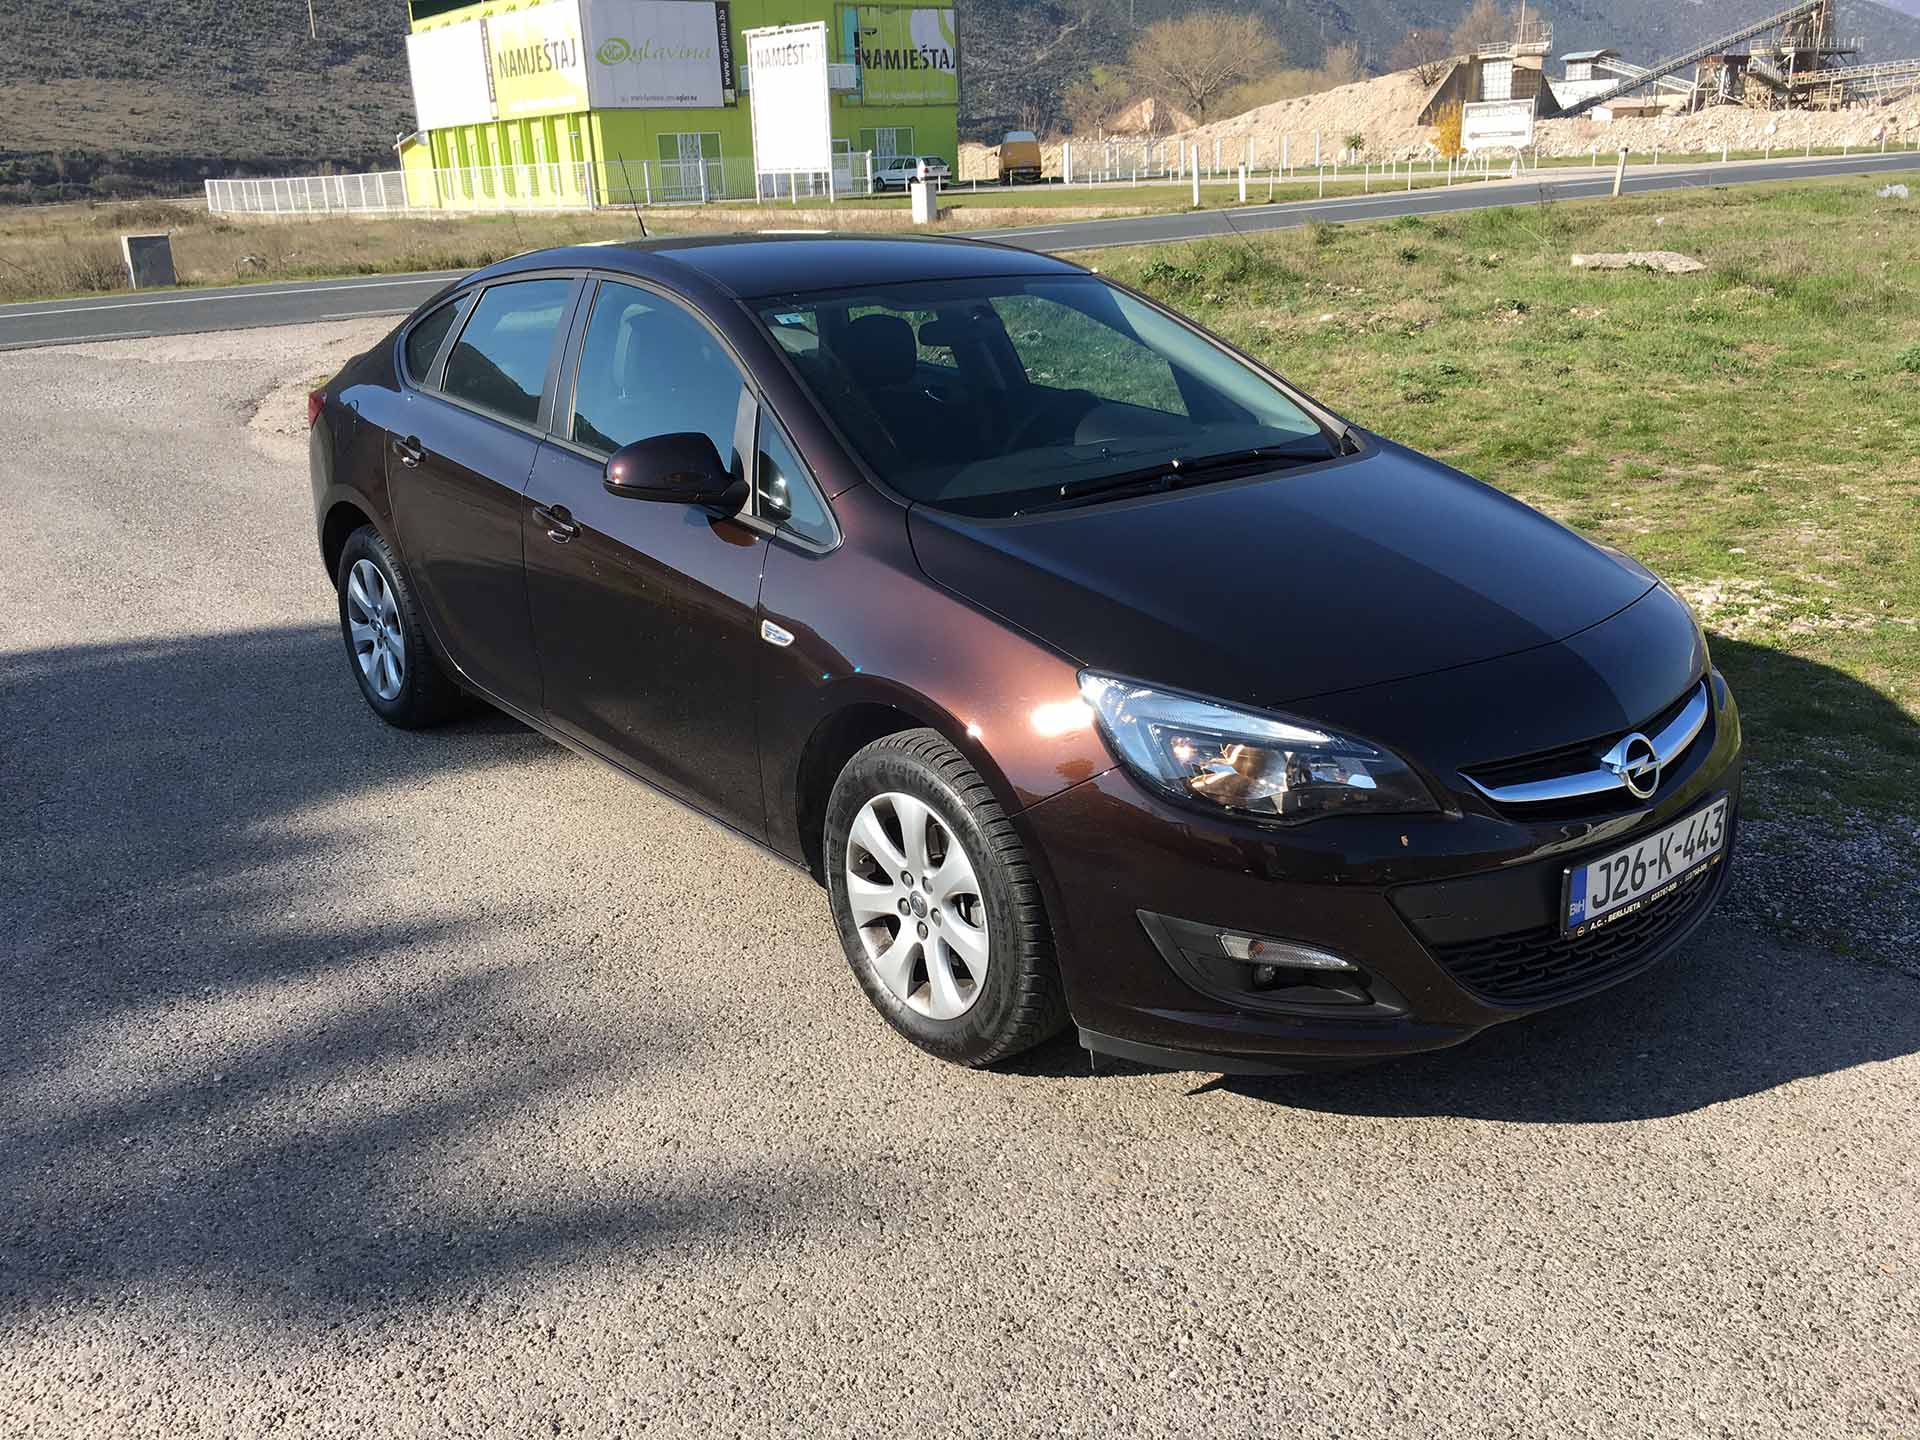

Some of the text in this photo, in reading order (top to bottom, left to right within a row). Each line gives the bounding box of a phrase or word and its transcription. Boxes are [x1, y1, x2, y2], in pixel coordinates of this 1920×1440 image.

[498, 38, 577, 80] NAMJEŠTAJ
[596, 37, 712, 65] Oglavina
[718, 9, 731, 86] www.oglavina.ba
[860, 43, 956, 71] NAMJEŠTAJ
[1591, 805, 1725, 909] J26-K-443
